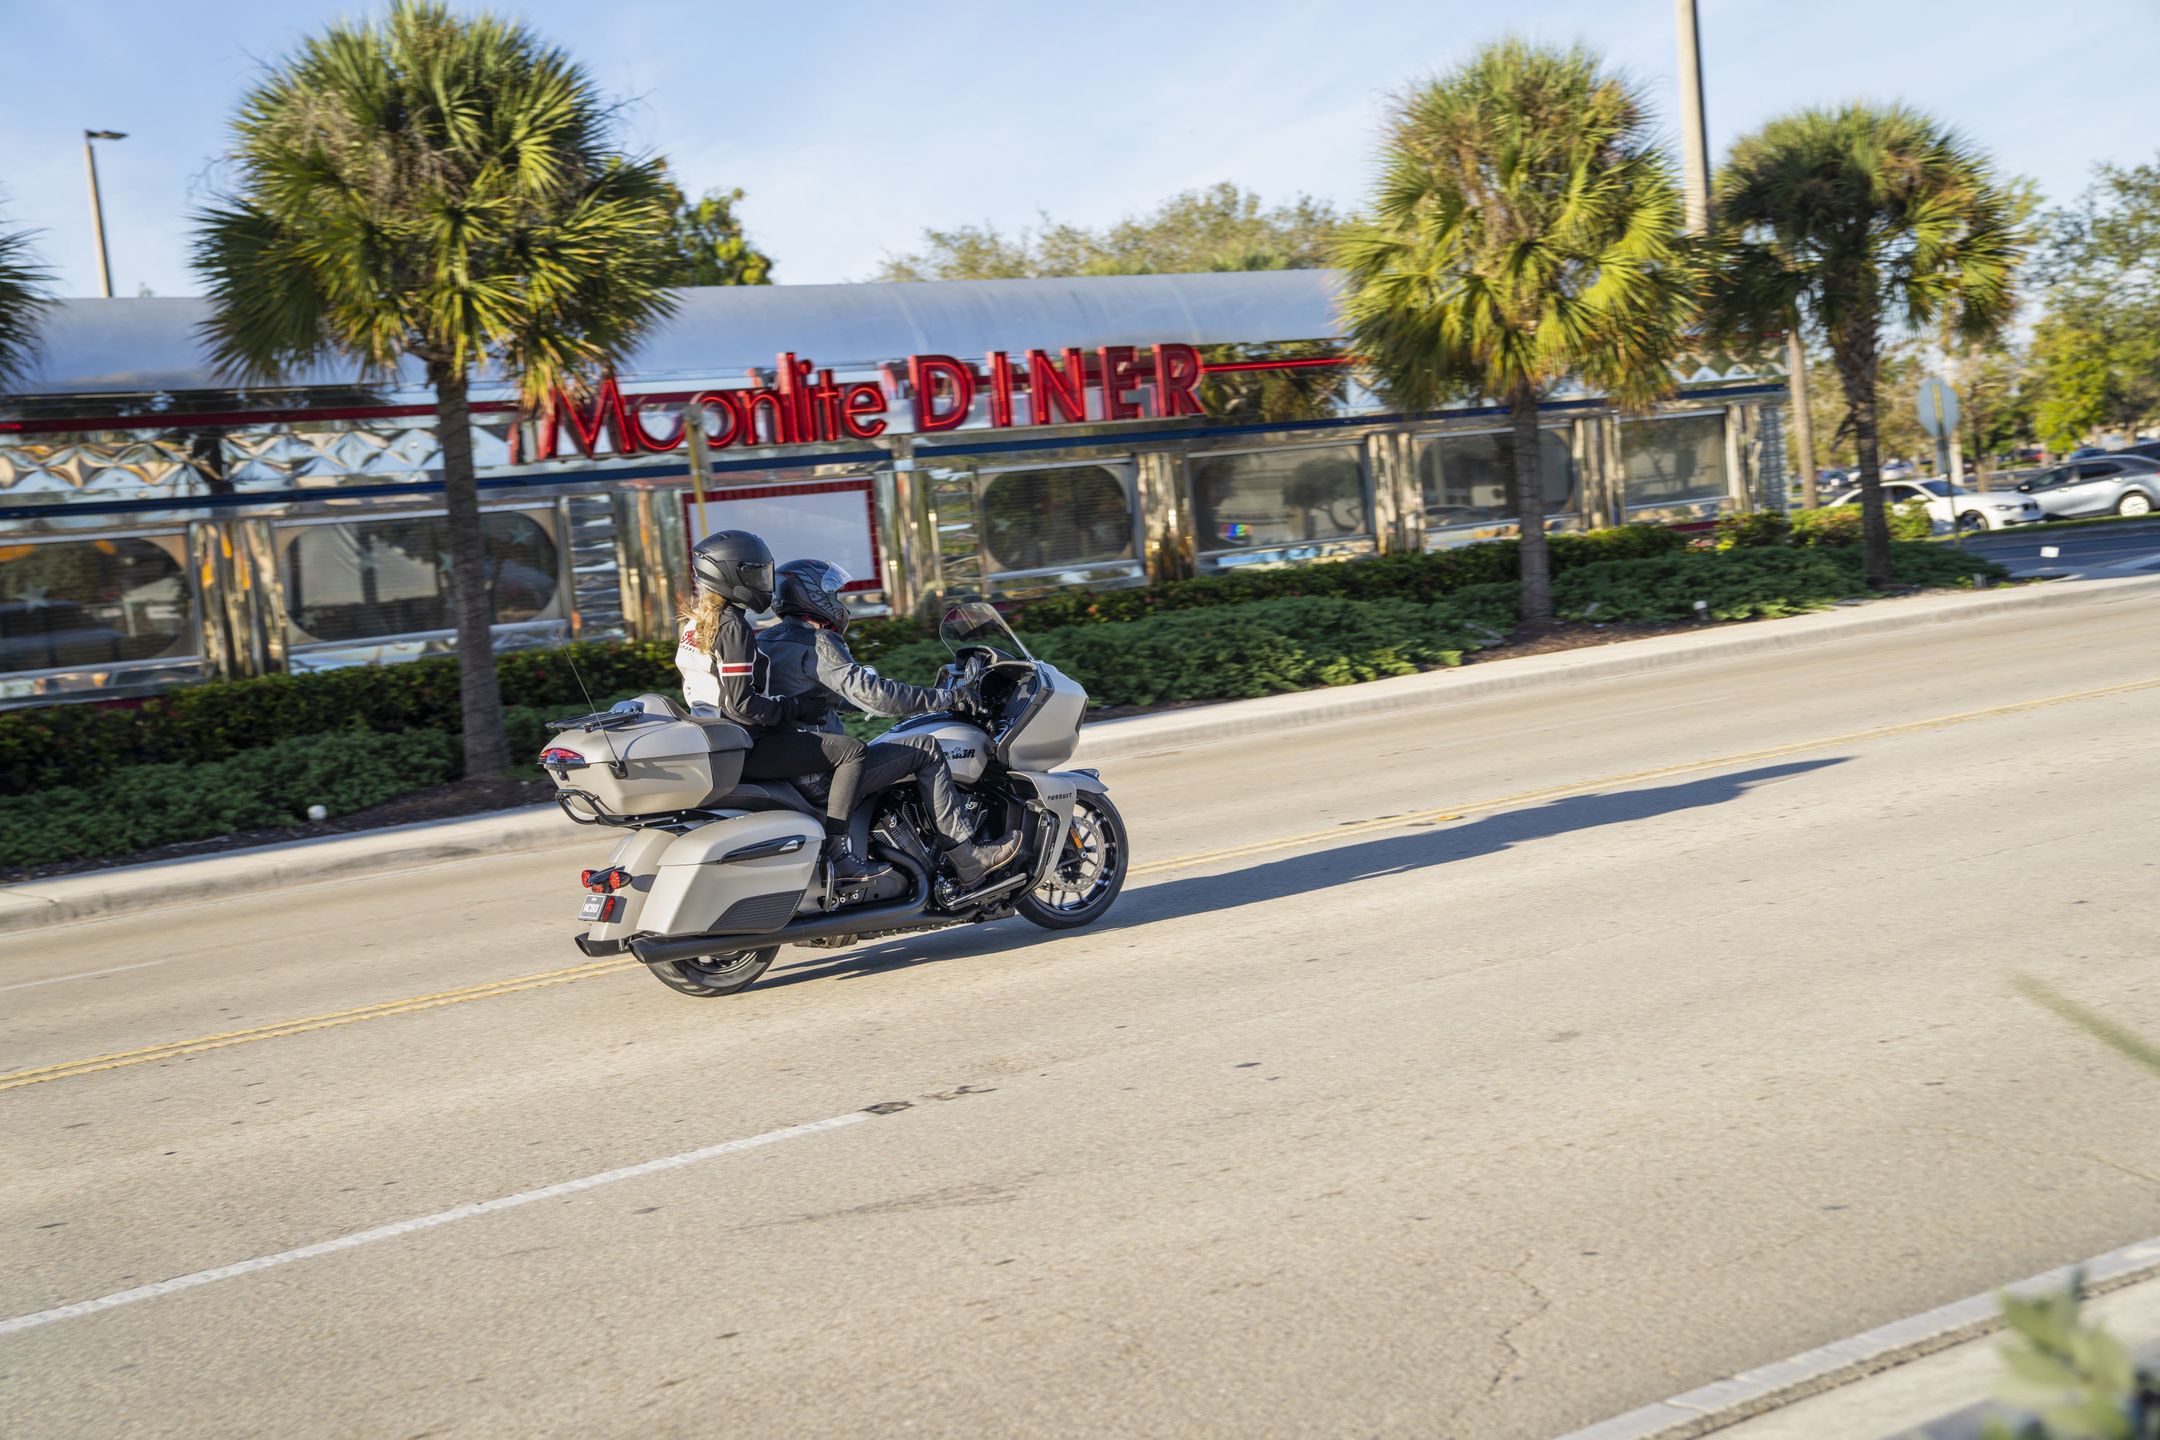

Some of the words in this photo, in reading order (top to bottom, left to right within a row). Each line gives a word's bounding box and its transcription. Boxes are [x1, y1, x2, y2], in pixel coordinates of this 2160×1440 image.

[539, 352, 888, 459] Moonlite
[909, 343, 1204, 432] DINER
[1047, 792, 1072, 801] PURSUIT
